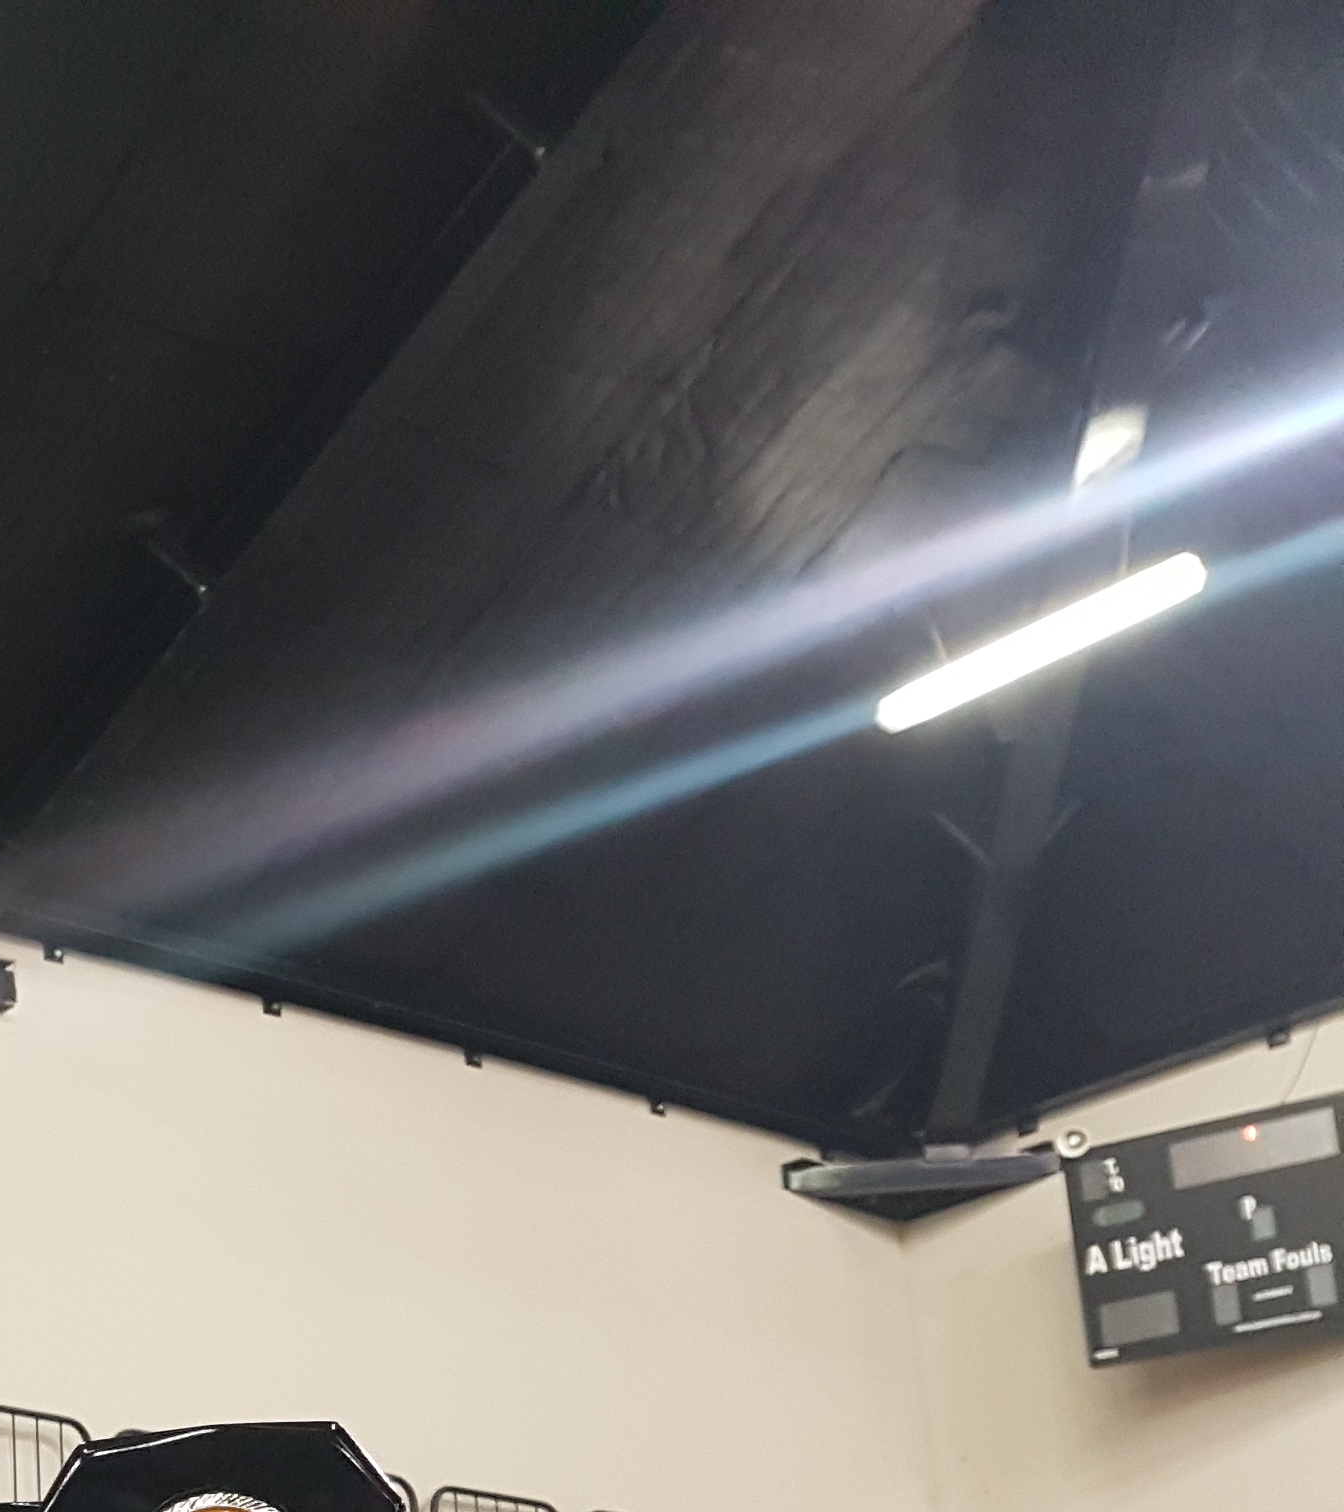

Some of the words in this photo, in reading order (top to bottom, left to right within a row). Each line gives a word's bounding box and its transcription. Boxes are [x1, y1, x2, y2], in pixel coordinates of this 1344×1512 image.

[1085, 1244, 1108, 1275] A
[1111, 1228, 1185, 1272] Light
[1204, 1257, 1269, 1286] Team
[1270, 1241, 1333, 1273] Fouls
